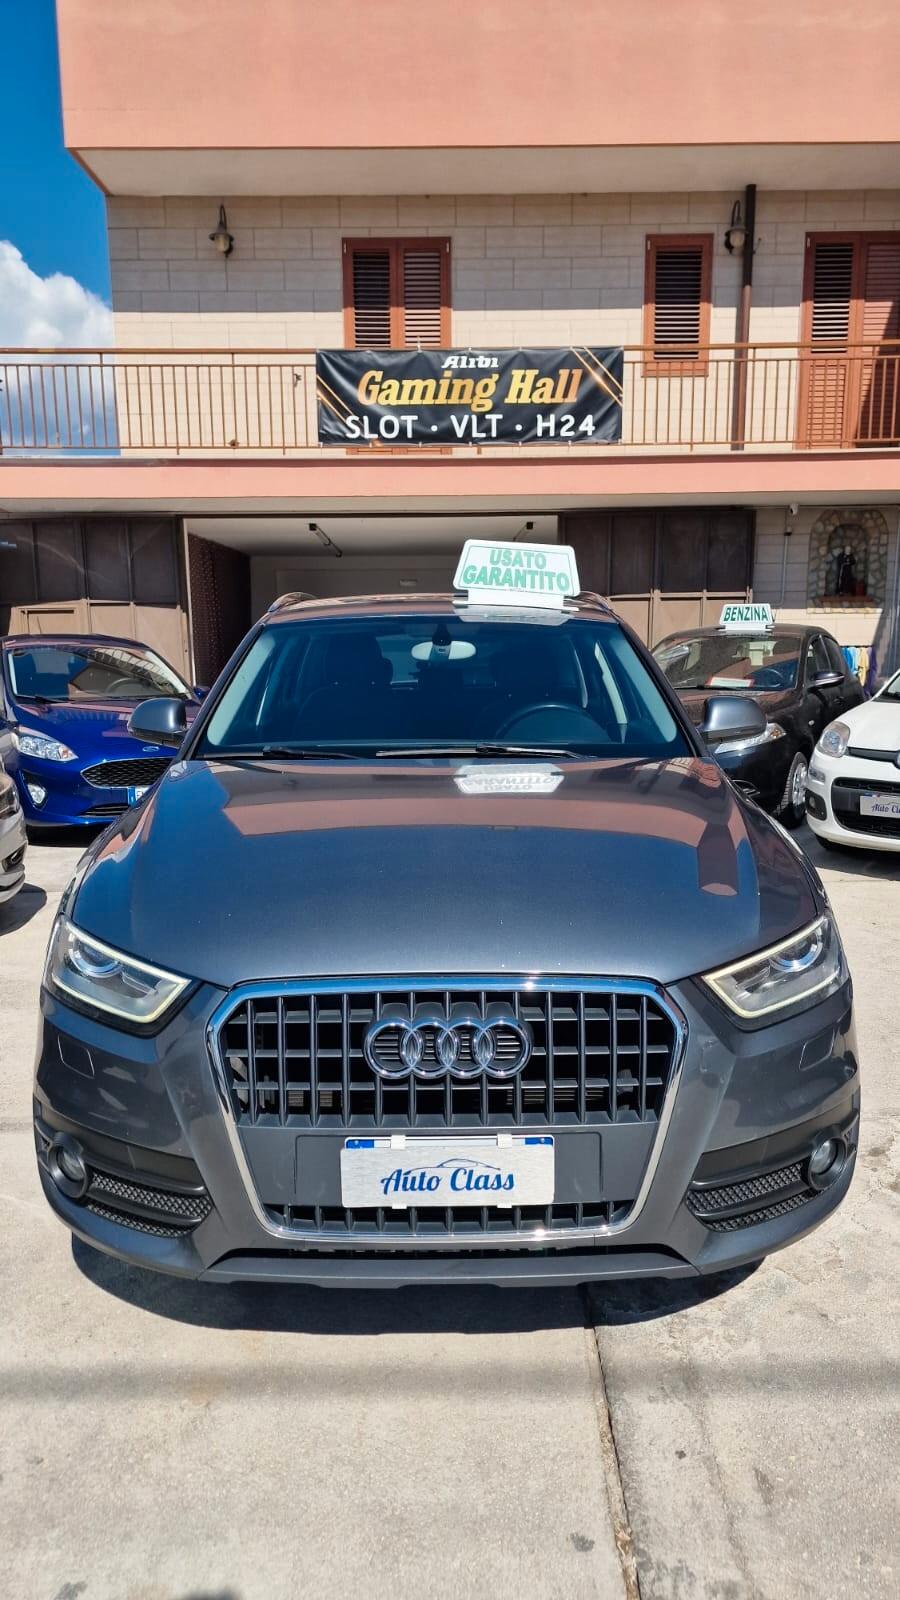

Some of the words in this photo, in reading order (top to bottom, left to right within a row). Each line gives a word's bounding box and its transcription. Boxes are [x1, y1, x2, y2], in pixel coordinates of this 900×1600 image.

[357, 369, 499, 412] Gaming
[504, 368, 583, 404] Hall
[345, 415, 418, 438] SLOT
[450, 414, 503, 438] VLT
[536, 414, 596, 438] H24
[489, 548, 547, 570] USATO
[462, 565, 570, 592] GARANTITO
[723, 606, 769, 622] BENZINA
[380, 1168, 442, 1195] Auto
[450, 1168, 515, 1192] Class
